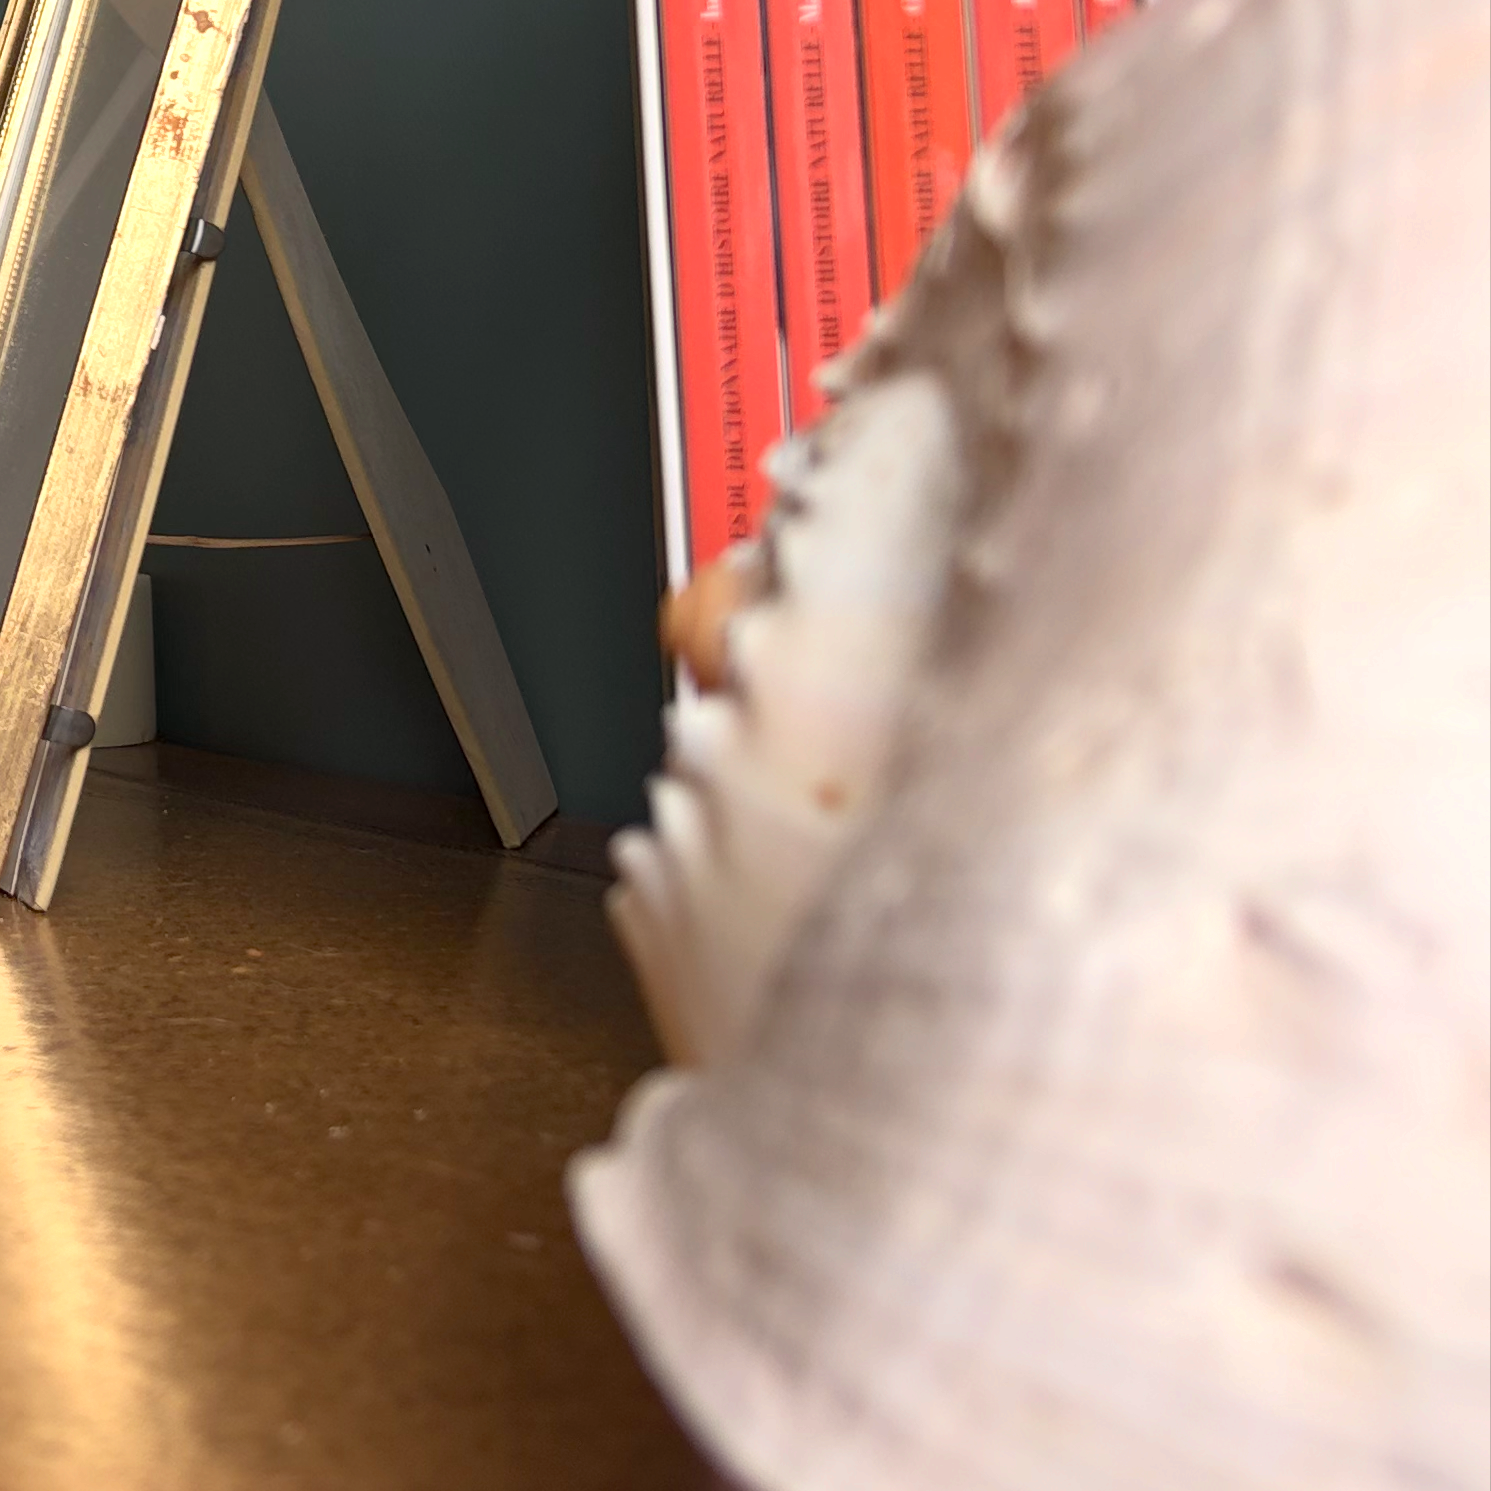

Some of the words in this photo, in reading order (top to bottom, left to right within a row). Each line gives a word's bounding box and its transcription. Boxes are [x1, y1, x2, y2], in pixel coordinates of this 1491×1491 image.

[702, 32, 726, 164] NATURELLE
[801, 38, 827, 170] NATURELLE
[903, 24, 933, 160] NATURELLE
[711, 169, 736, 300] D'HISTOIRE
[810, 179, 838, 307] D'HISTOIRE
[718, 309, 745, 473] DICTIONNAIRE
[725, 481, 747, 509] DU
